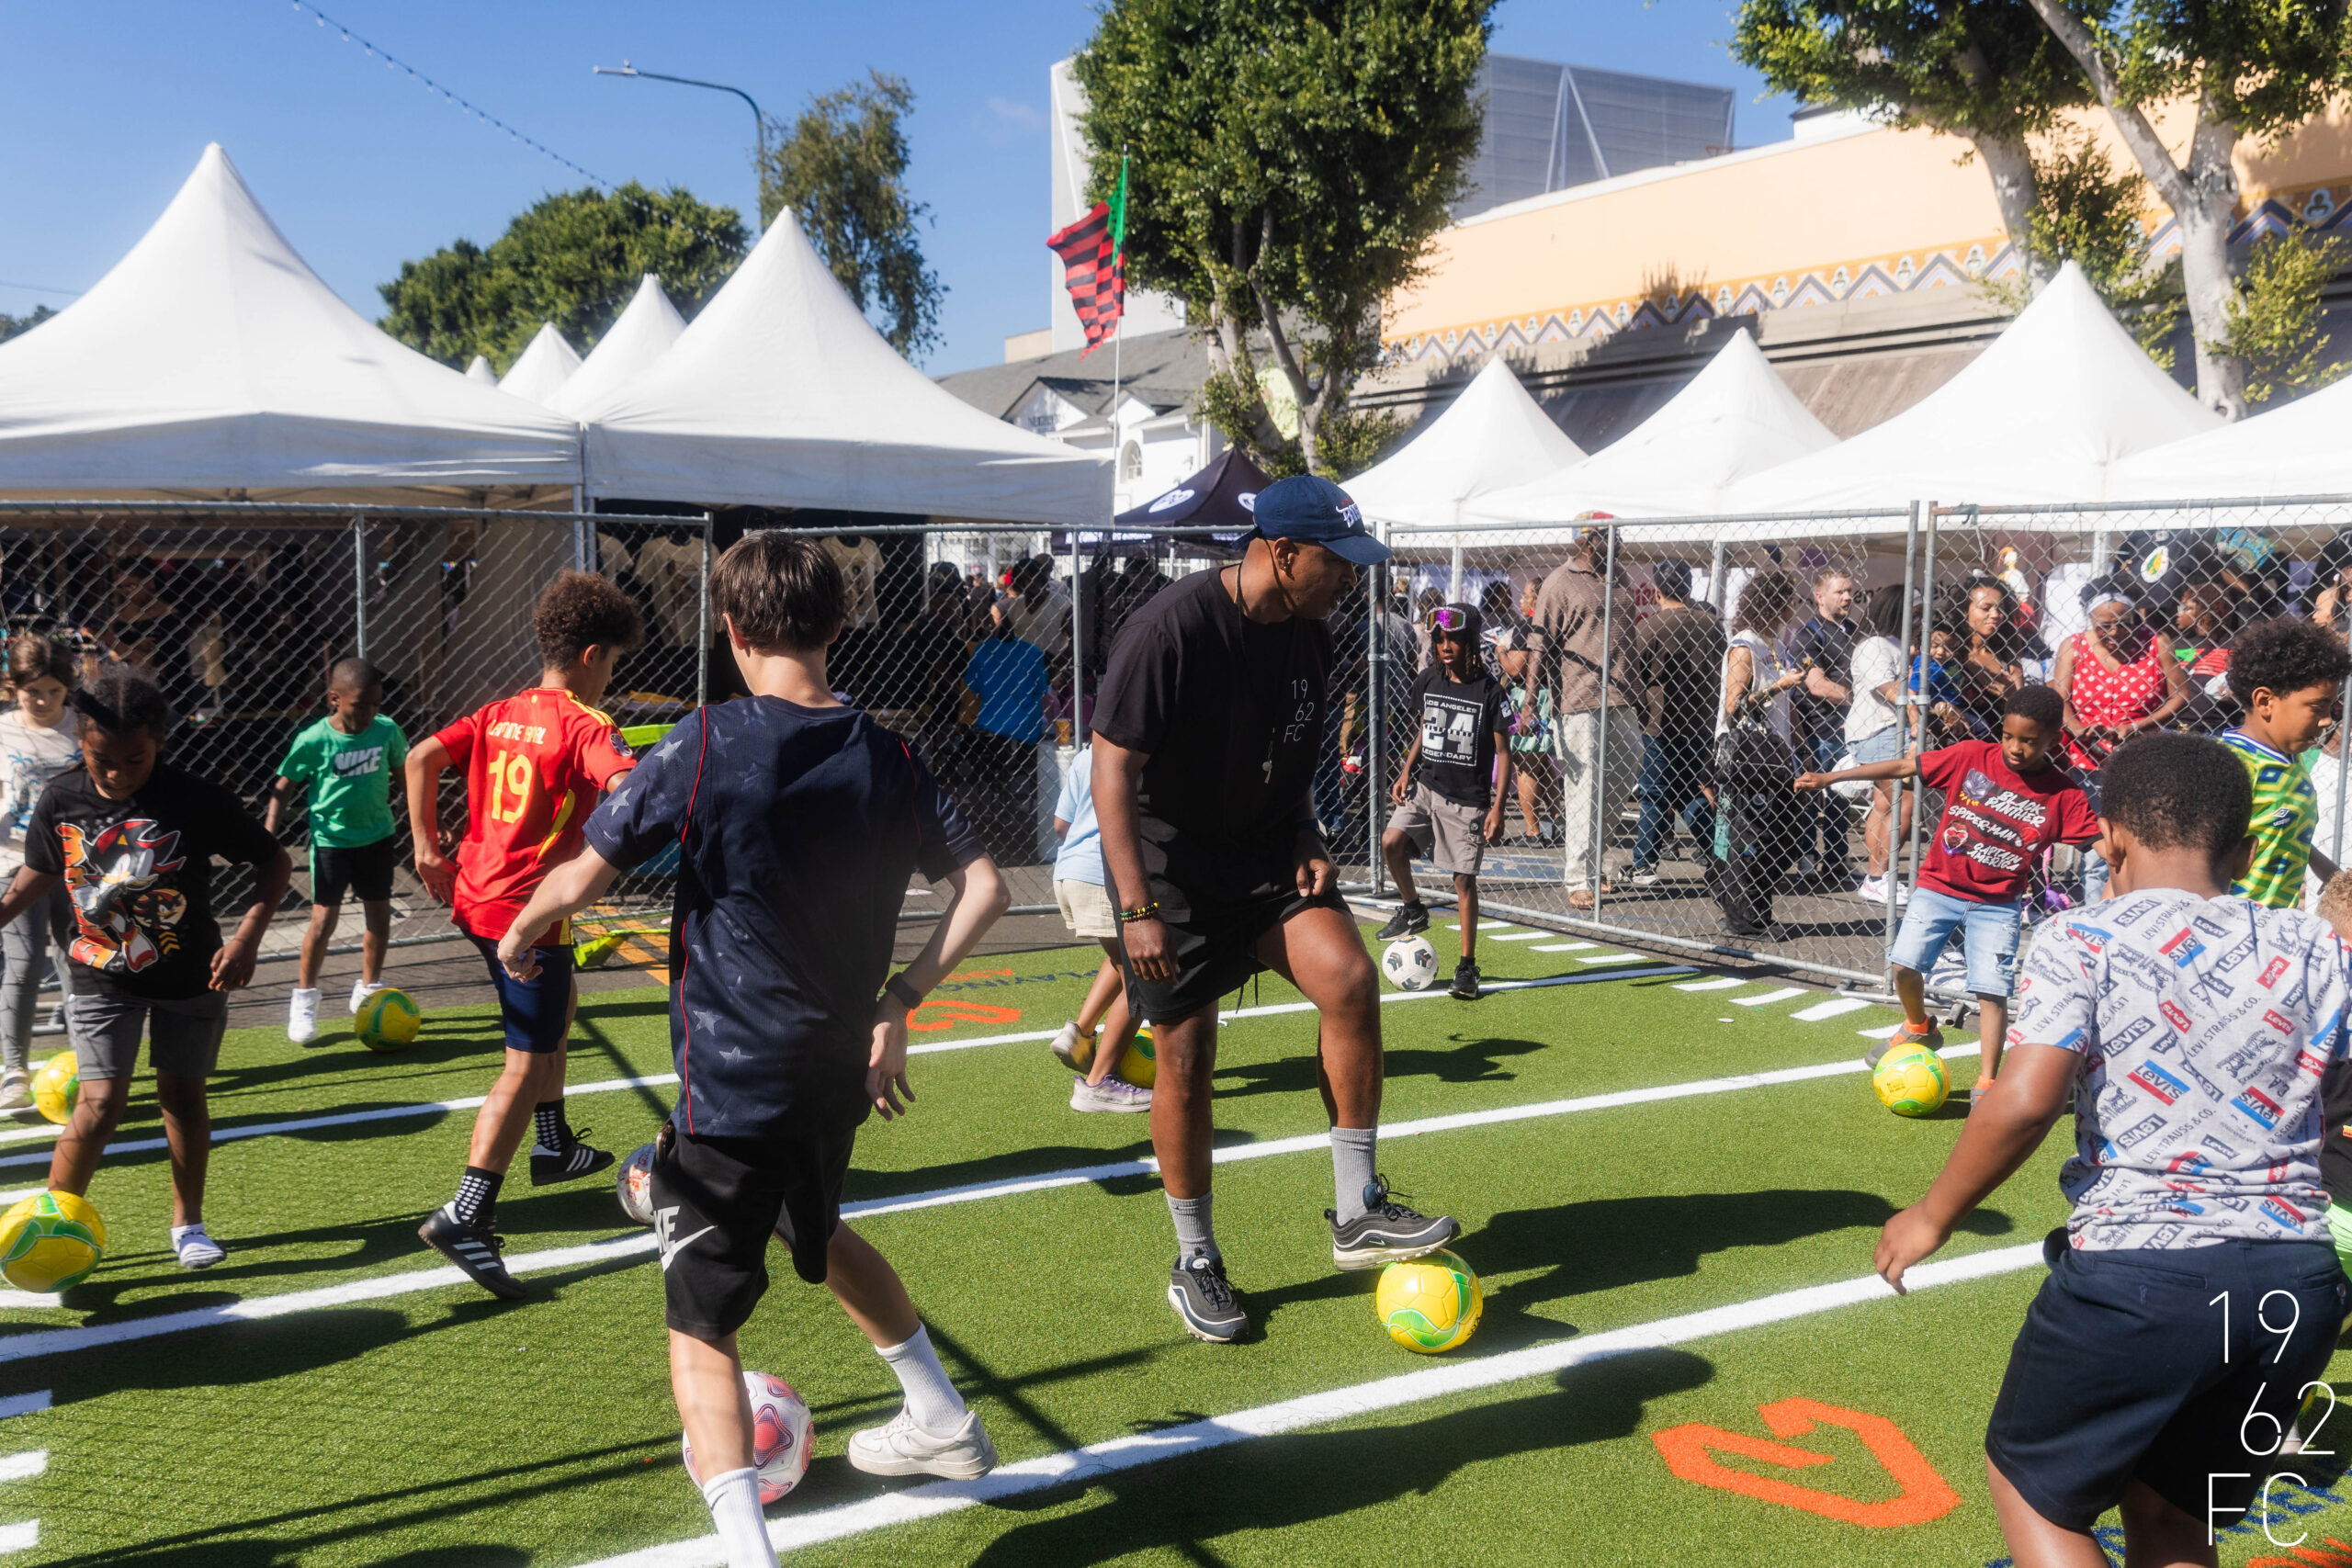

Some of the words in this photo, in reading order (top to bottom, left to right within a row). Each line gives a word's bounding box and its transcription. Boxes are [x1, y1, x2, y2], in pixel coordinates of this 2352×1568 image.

[1292, 679, 1307, 698] 19
[1295, 702, 1315, 721] 62
[1440, 701, 1476, 713] ANGELES
[1283, 724, 1305, 742] FC
[1422, 707, 1475, 755] 24
[1421, 747, 1472, 761] LEGENDARY
[489, 750, 533, 823] 19
[1984, 797, 2046, 828] PANTHER
[1997, 790, 2046, 815] BLACK
[1948, 805, 2018, 842] SPIDER-MAN
[1966, 851, 2020, 871] AMERICA
[1973, 842, 2024, 864] CAPTAIN
